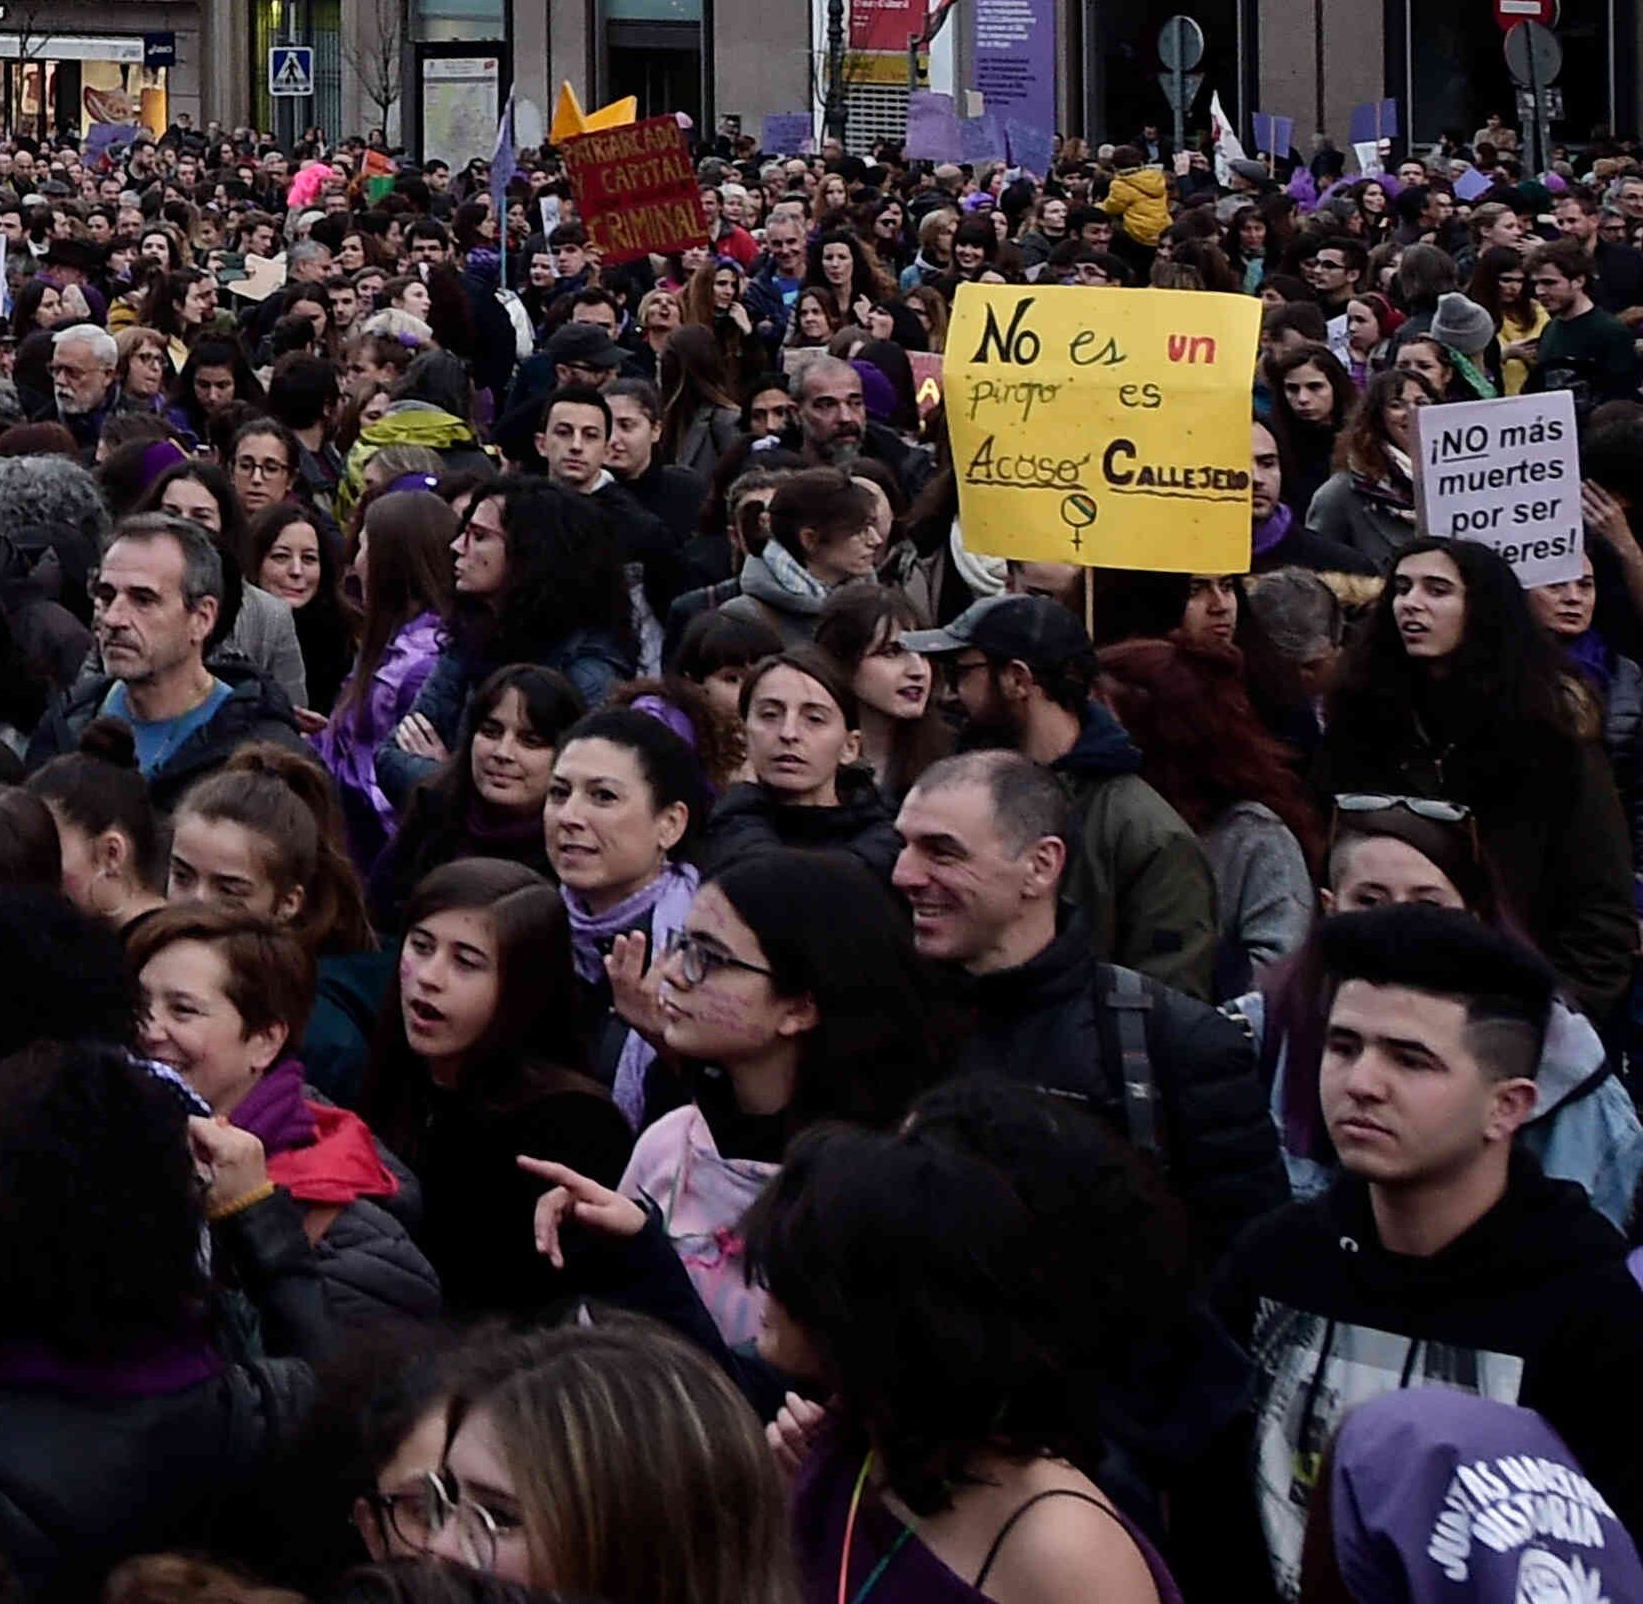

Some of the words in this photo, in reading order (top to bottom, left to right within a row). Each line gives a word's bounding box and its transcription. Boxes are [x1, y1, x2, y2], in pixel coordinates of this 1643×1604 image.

[586, 198, 710, 254] CRIMINAL
[970, 297, 1040, 365] No
[1069, 330, 1127, 365] es
[1167, 334, 1216, 364] un
[1119, 383, 1162, 408] es
[1431, 425, 1489, 465] ¡NO
[1500, 415, 1563, 448] más
[1438, 459, 1564, 495] muertes
[1452, 506, 1504, 539] por
[1512, 498, 1562, 524] ser
